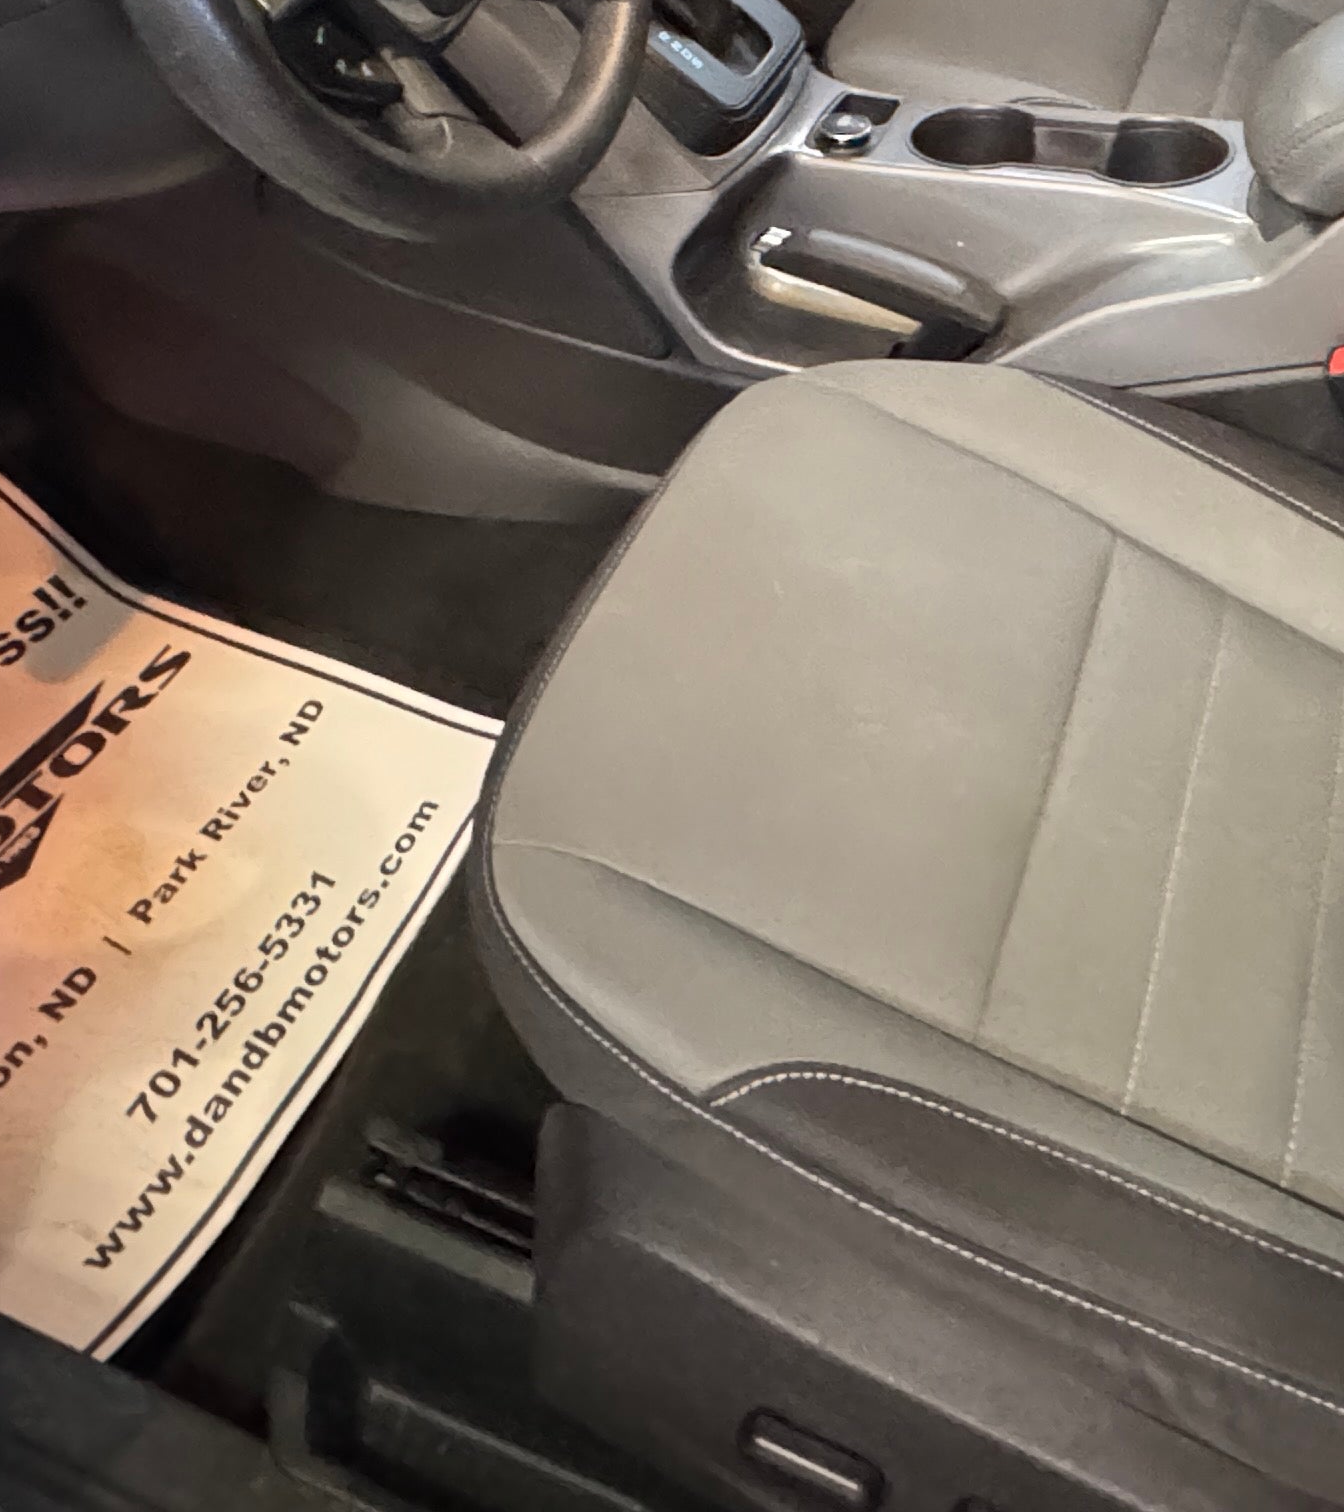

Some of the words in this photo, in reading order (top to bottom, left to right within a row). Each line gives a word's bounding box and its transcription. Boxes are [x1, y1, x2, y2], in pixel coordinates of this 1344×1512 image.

[37, 966, 98, 1023] ND
[126, 848, 208, 925] Park
[199, 754, 291, 843] River,
[278, 698, 324, 747] ND
[126, 869, 338, 1126] 701-256-5331
[82, 798, 441, 1271] www.dandbmotors.com
